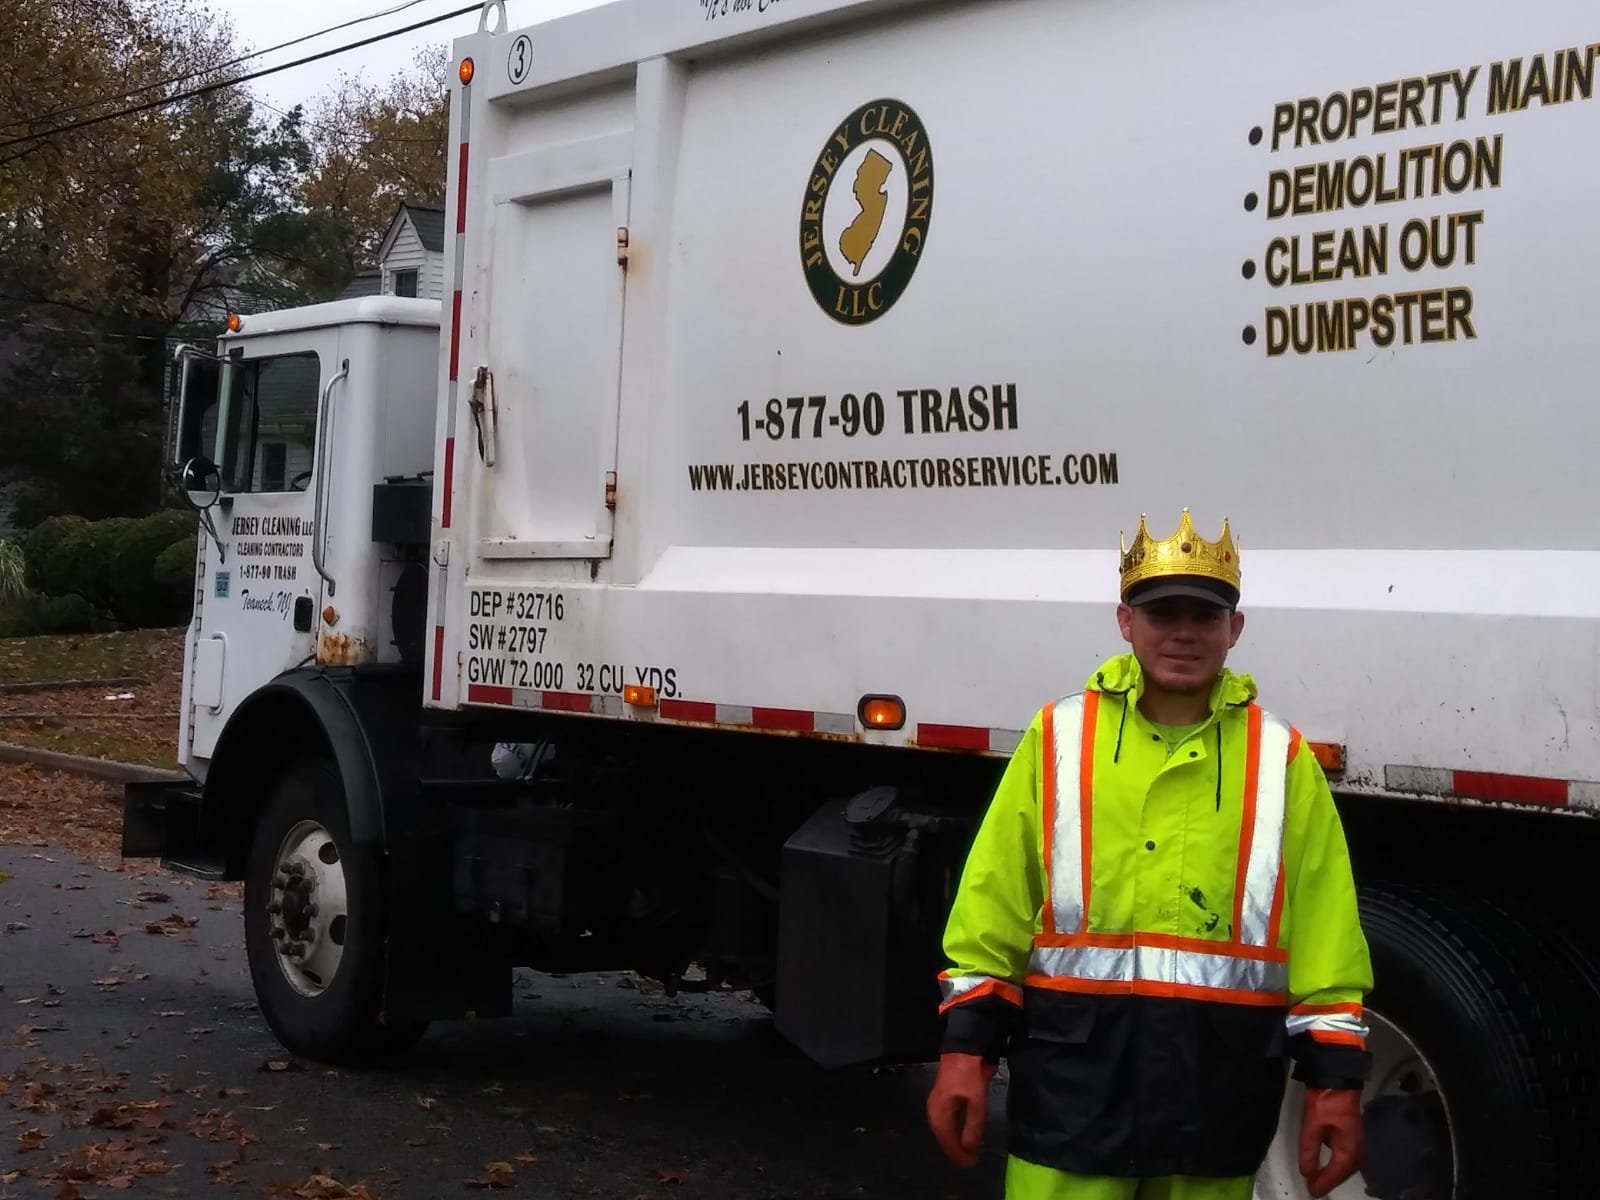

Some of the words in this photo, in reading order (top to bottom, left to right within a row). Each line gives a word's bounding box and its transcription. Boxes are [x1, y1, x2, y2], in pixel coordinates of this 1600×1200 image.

[1271, 65, 1482, 152] PROPERTY
[804, 124, 850, 268] JERSEY
[859, 105, 929, 257] CLEANING
[1267, 133, 1504, 220] DEMOLITION
[1265, 222, 1389, 288] CLEAN
[1399, 209, 1484, 272] OUT
[835, 283, 884, 317] LLC
[1265, 286, 1478, 357] DUMPSTER
[736, 392, 885, 441] 1-877-90
[897, 383, 1019, 434] TRASH
[688, 453, 1120, 491] WWW.JERSEYCONTRACTORSERVICE.COM
[232, 516, 260, 536] JERSEY
[262, 516, 301, 536] CLEANING
[302, 521, 313, 536] LLC
[237, 542, 263, 556] CLEANING
[264, 543, 304, 557] CONTRACTORS
[240, 564, 271, 580] 1-877-90
[274, 565, 297, 580] TRASH
[470, 591, 502, 617] DEP
[506, 592, 564, 621] #32716
[469, 624, 494, 650] SW
[498, 626, 547, 654] #2797
[468, 657, 505, 684] GVW
[510, 660, 564, 690] 72.000
[577, 663, 595, 691] 32
[600, 664, 624, 693] CU
[635, 666, 683, 699] YDS.
